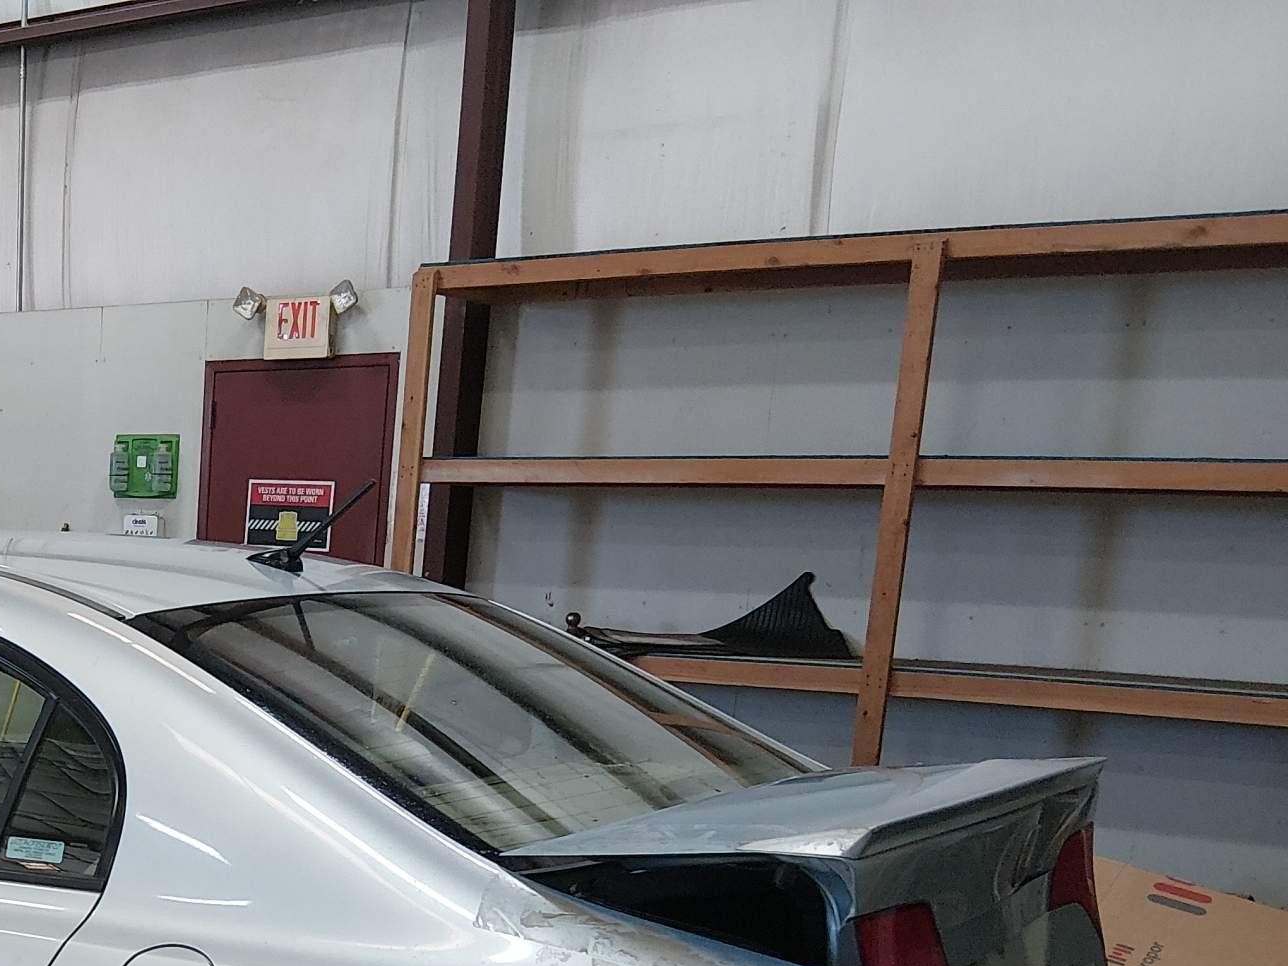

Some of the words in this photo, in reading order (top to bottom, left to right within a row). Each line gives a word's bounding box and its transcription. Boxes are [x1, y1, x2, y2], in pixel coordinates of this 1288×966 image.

[277, 300, 321, 340] EXIT
[262, 494, 286, 502] BEYOND
[300, 495, 319, 503] POINT
